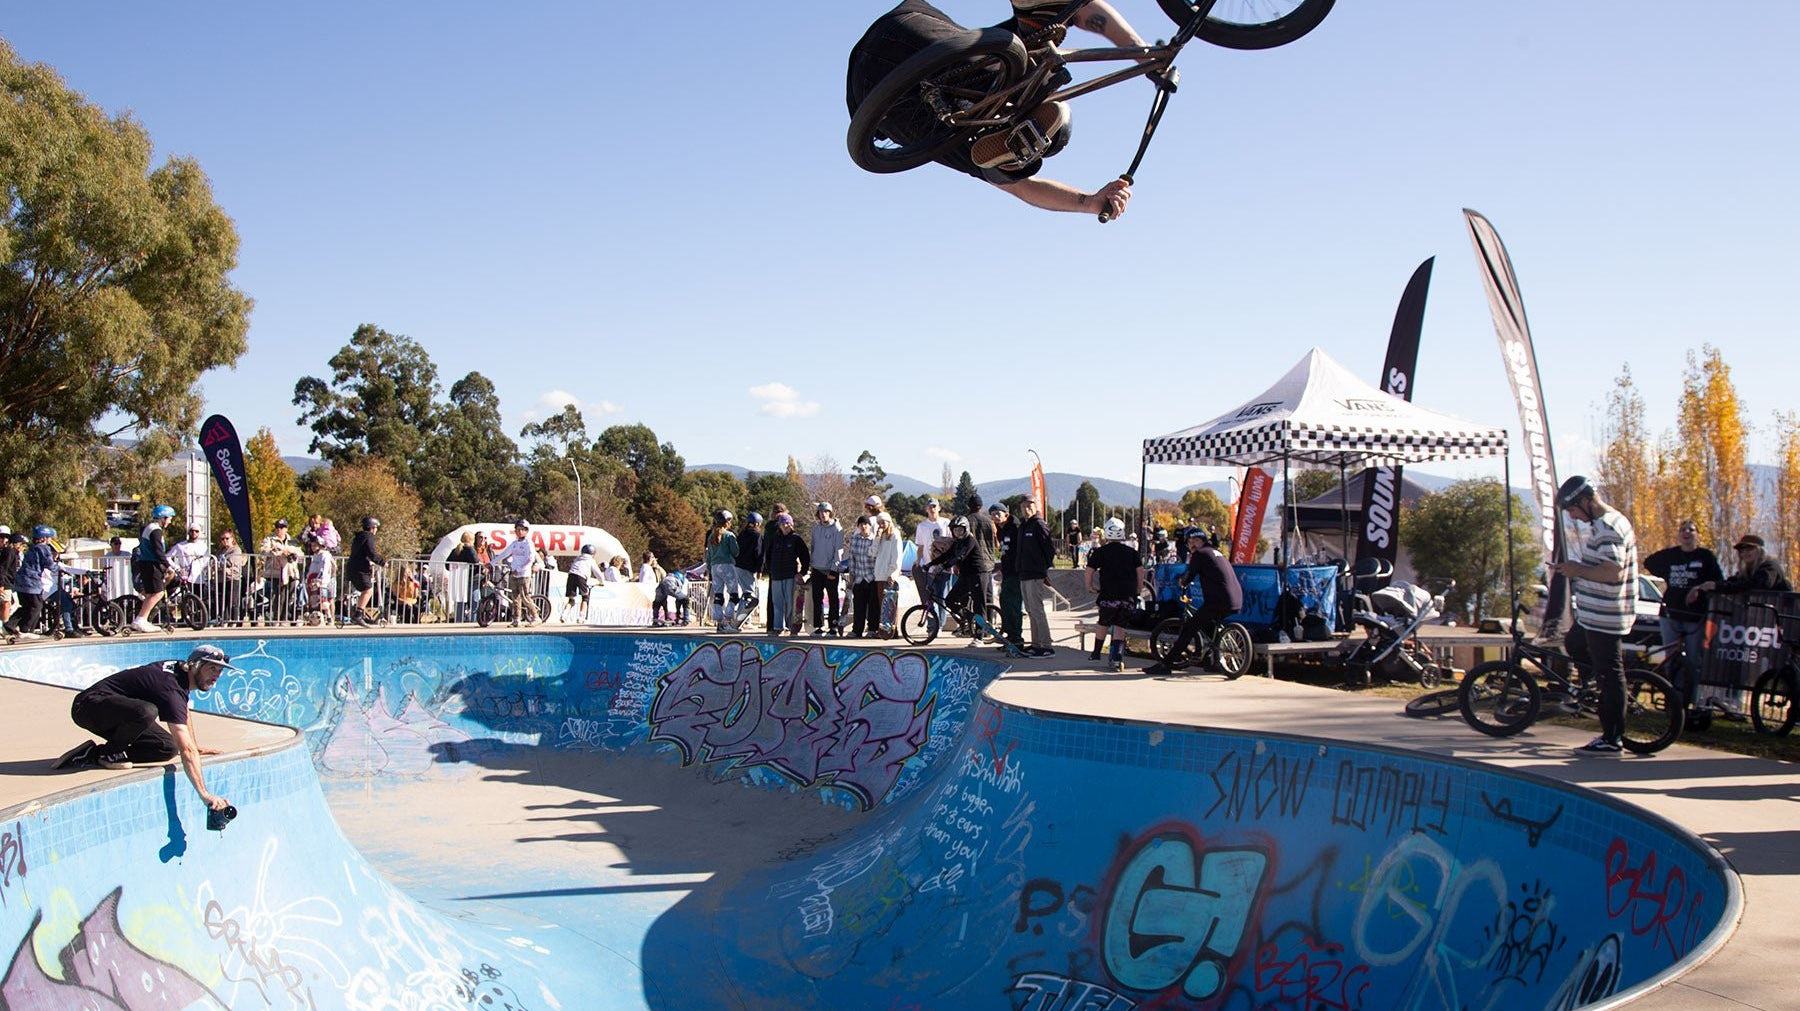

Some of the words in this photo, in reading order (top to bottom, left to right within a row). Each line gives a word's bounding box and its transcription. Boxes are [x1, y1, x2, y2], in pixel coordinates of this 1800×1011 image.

[1236, 401, 1284, 418] VANS
[216, 448, 242, 496] Sendy
[490, 529, 585, 552] SART
[1719, 619, 1784, 649] boost
[1716, 647, 1758, 663] mobile
[961, 786, 994, 817] bigger
